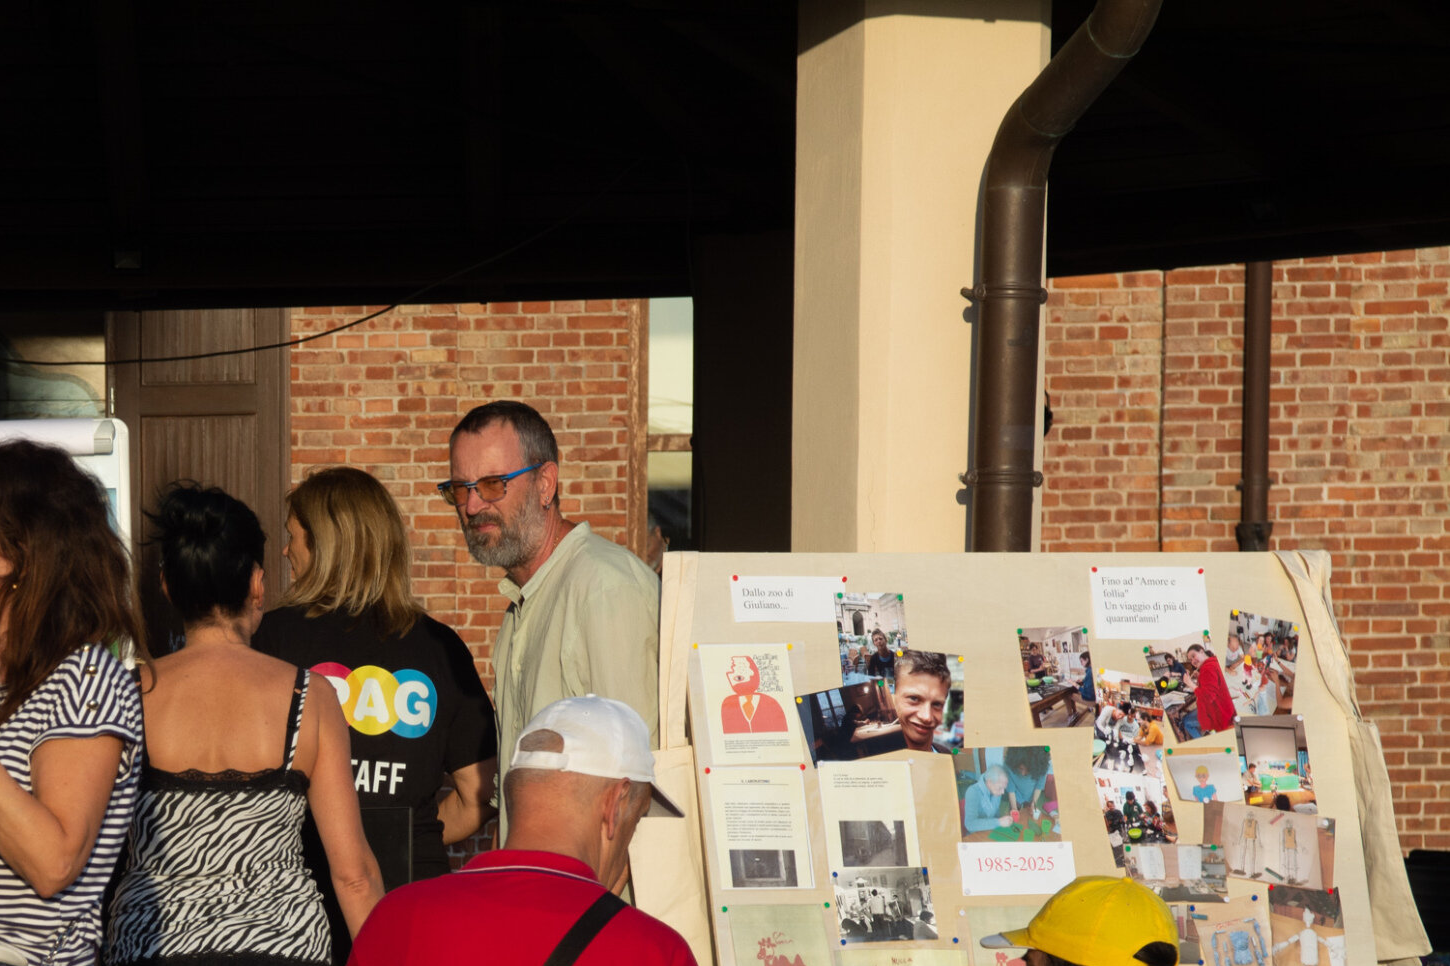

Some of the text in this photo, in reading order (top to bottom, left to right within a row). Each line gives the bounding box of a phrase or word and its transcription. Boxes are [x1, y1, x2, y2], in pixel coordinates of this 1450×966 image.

[1101, 577, 1121, 586] Fino
[1123, 577, 1133, 586] ad
[1135, 577, 1169, 586] "Amore
[742, 588, 766, 597] Dallo
[785, 588, 794, 597] di
[1103, 589, 1129, 598] follia"
[743, 600, 789, 610] Giuliano...
[1104, 601, 1187, 613] Un viaggio di più di
[1106, 614, 1159, 624] quarant'anni!
[977, 856, 1055, 873] 1985-2025
